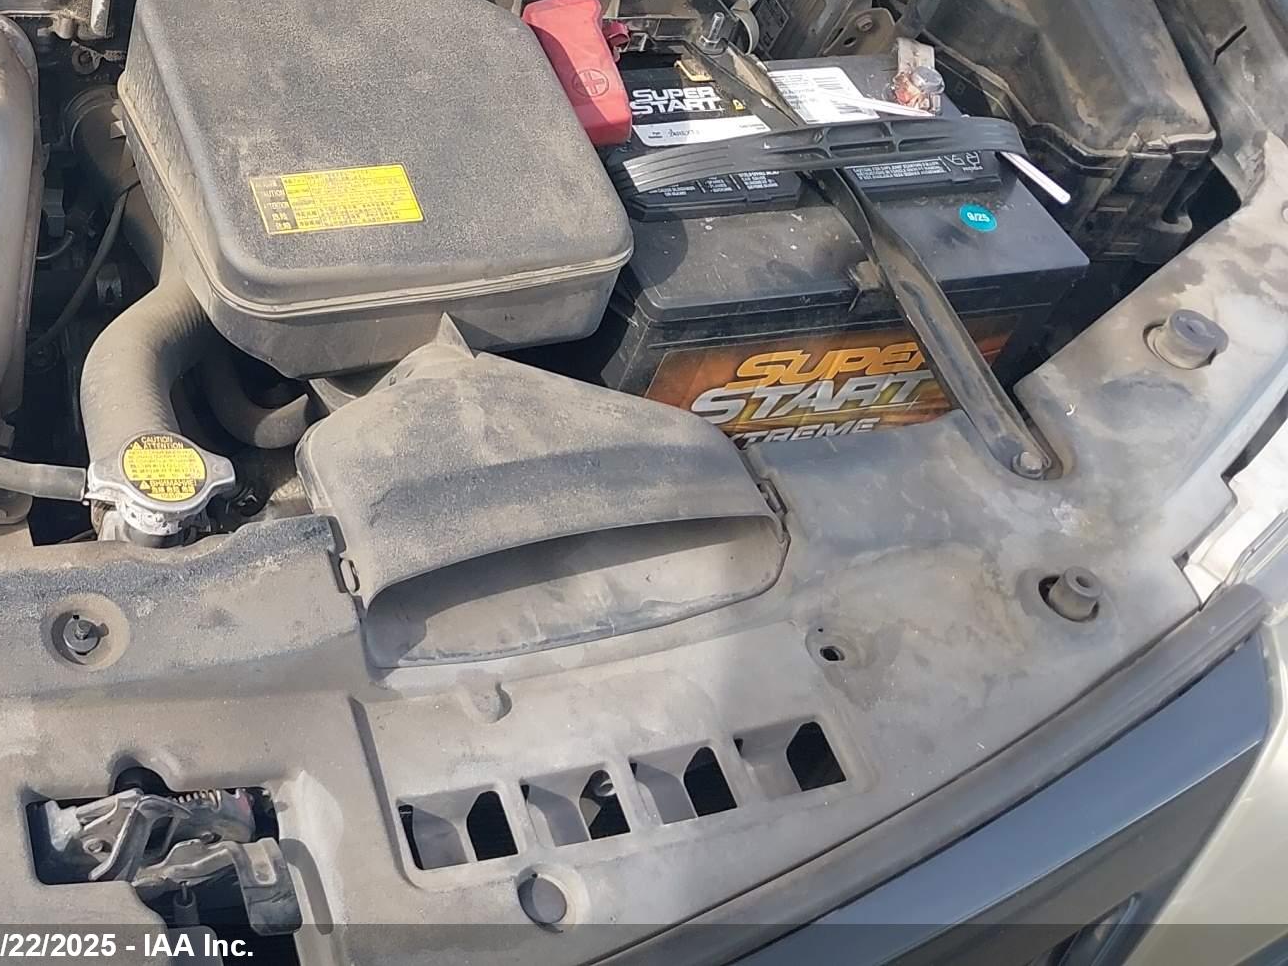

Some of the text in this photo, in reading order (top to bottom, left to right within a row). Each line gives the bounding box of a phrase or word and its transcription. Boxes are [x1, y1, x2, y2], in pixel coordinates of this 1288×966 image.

[632, 86, 721, 103] SUPER
[629, 98, 720, 116] START
[724, 342, 926, 391] SUPE
[690, 369, 935, 425] START
[144, 442, 184, 450] ATTENTION
